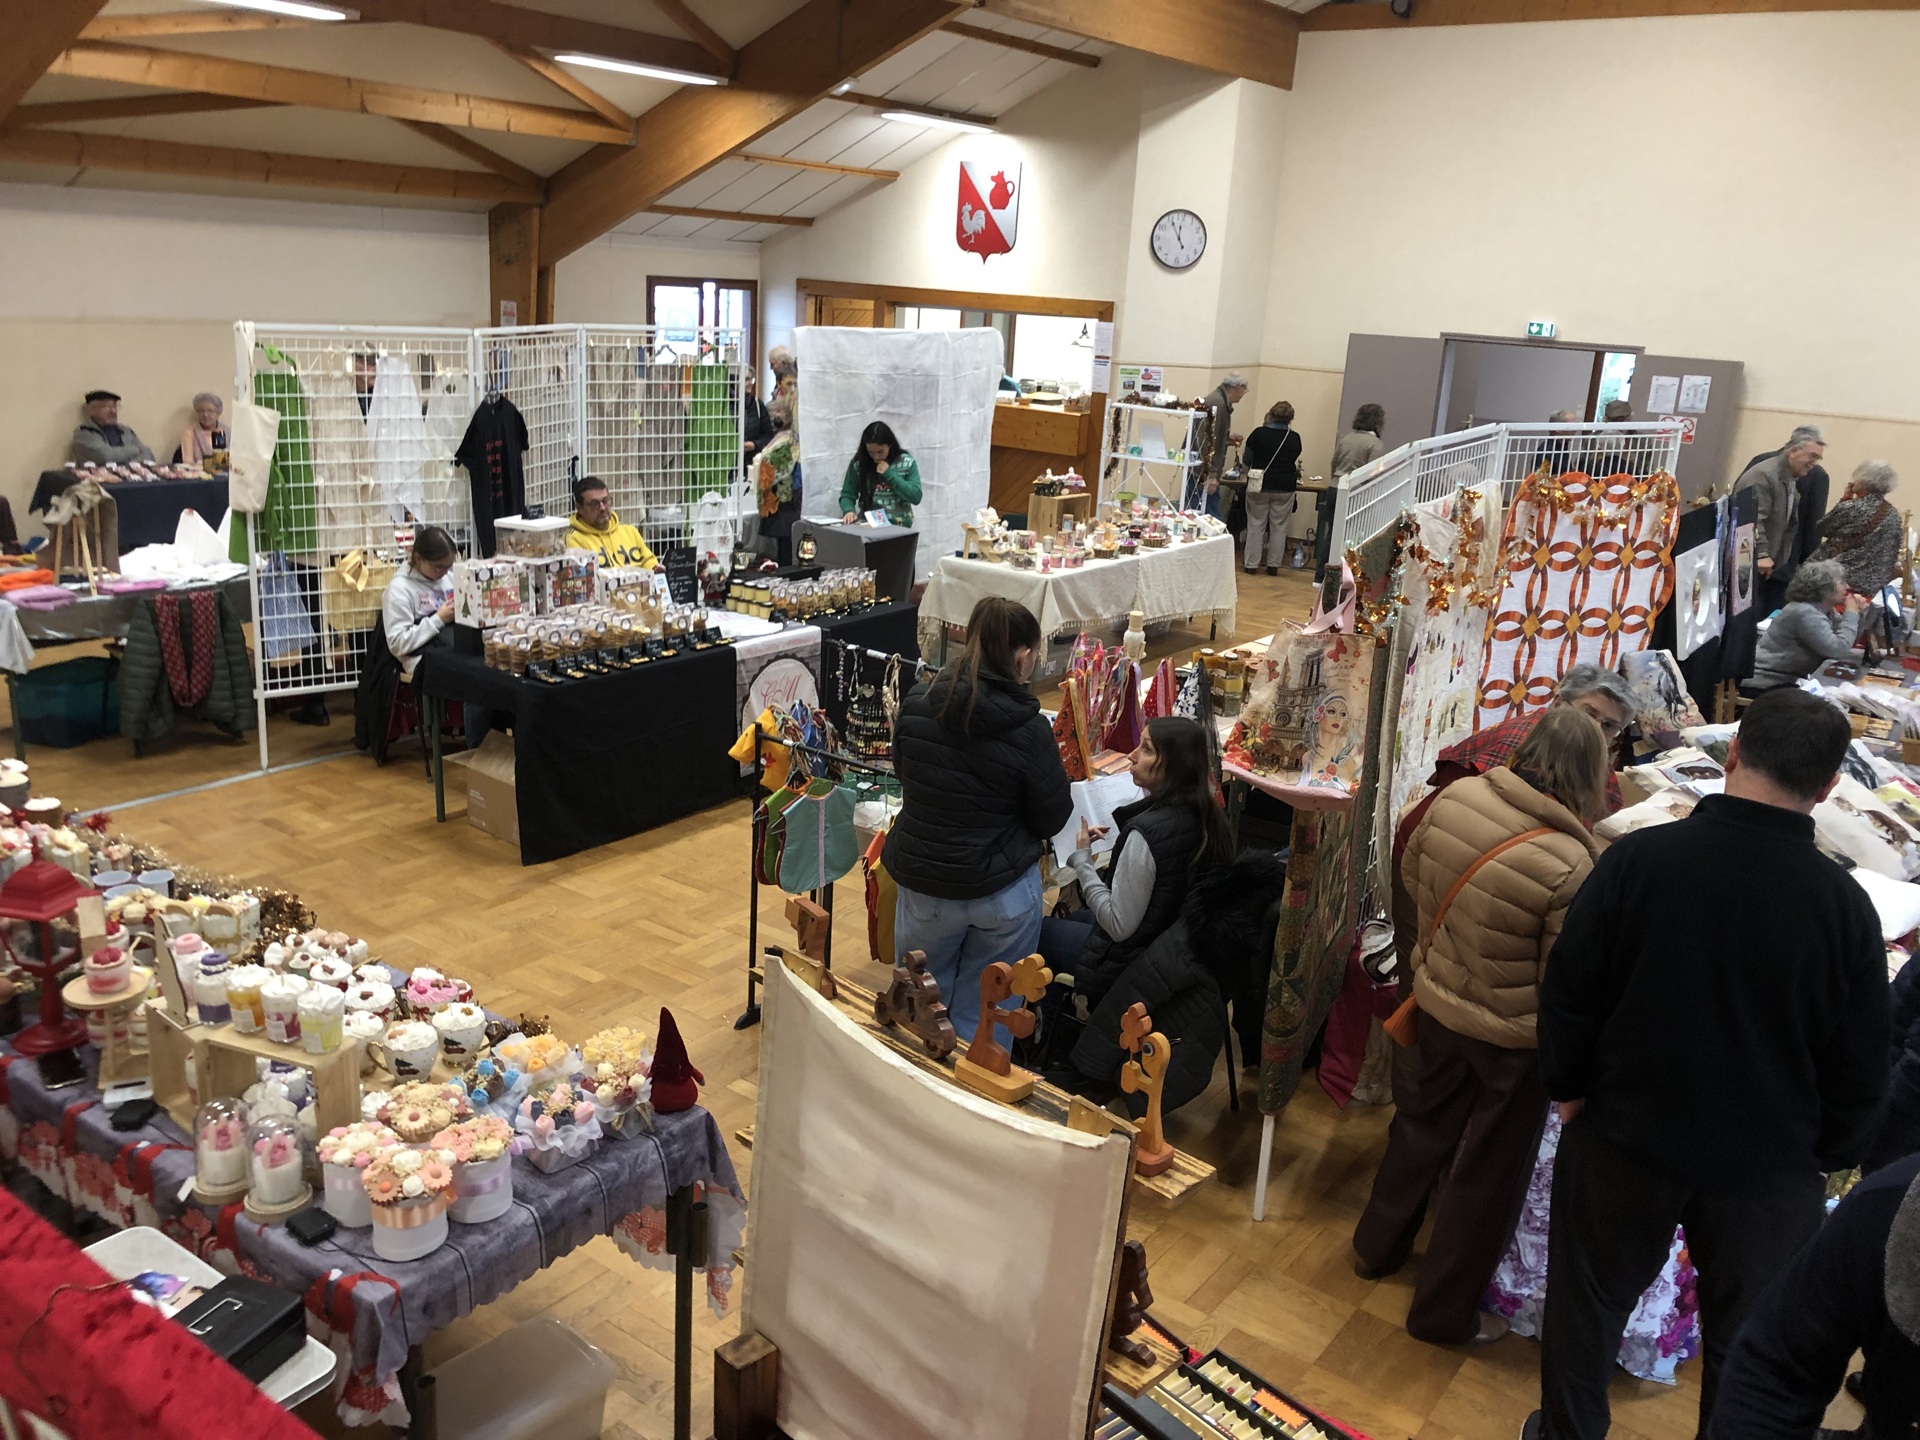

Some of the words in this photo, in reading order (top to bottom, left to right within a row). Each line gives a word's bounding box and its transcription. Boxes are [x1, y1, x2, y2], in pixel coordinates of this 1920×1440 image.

[1176, 212, 1187, 221] 12
[1195, 226, 1200, 234] 2
[1155, 234, 1161, 243] 9
[1197, 237, 1202, 245] 3
[1164, 252, 1168, 261] 7
[1185, 255, 1190, 263] 5
[1174, 257, 1180, 265] 6
